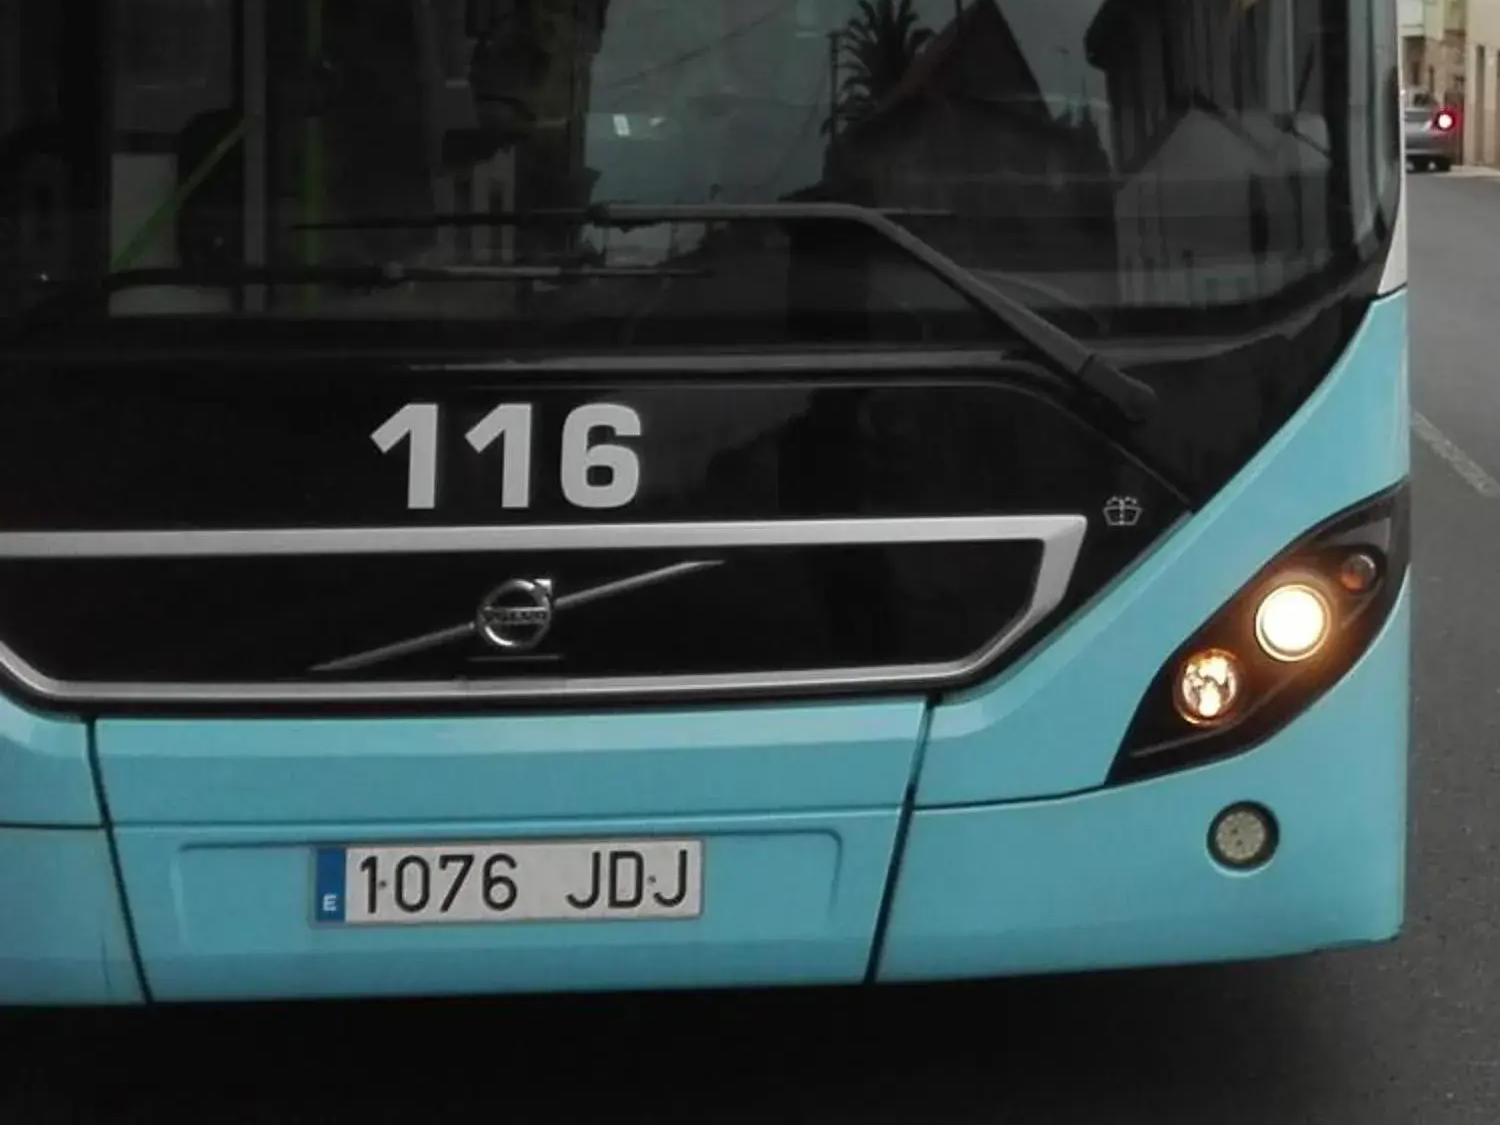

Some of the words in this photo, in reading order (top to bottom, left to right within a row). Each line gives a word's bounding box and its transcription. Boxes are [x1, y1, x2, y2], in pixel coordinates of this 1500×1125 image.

[369, 402, 642, 510] 116
[322, 893, 337, 913] E
[359, 853, 518, 915] 1076
[565, 849, 688, 910] JDJ
